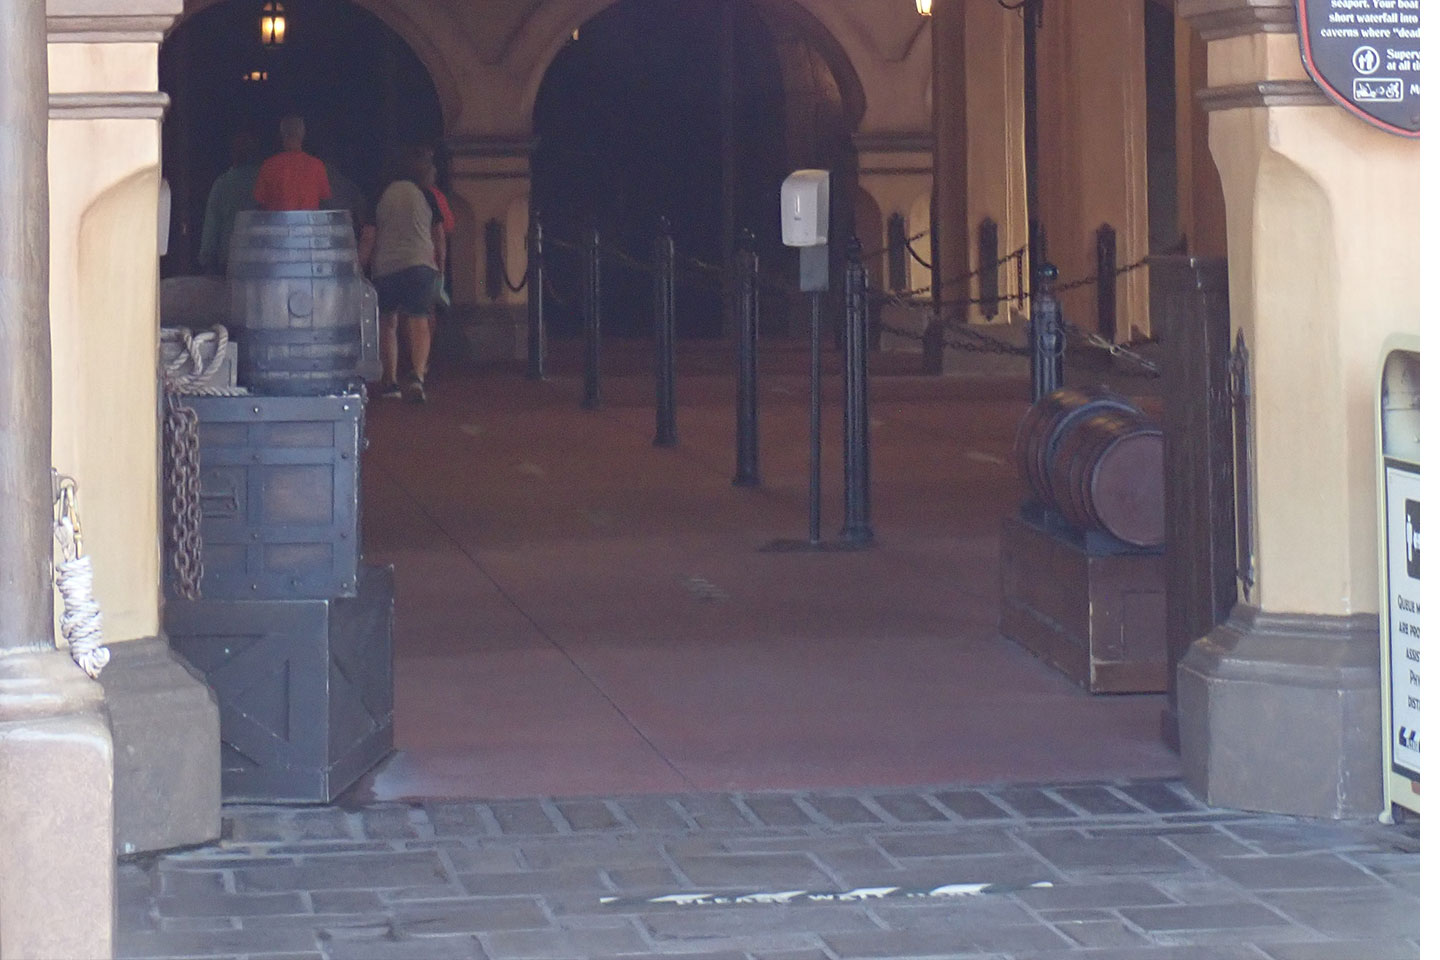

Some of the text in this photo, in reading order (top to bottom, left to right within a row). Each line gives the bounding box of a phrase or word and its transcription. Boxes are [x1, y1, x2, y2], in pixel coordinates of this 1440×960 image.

[1331, 0, 1370, 10] seaport.
[1329, 12, 1419, 23] short waterfall into
[1320, 28, 1359, 38] caverns
[1360, 27, 1391, 38] where
[1386, 61, 1397, 71] at
[1398, 60, 1411, 71] all
